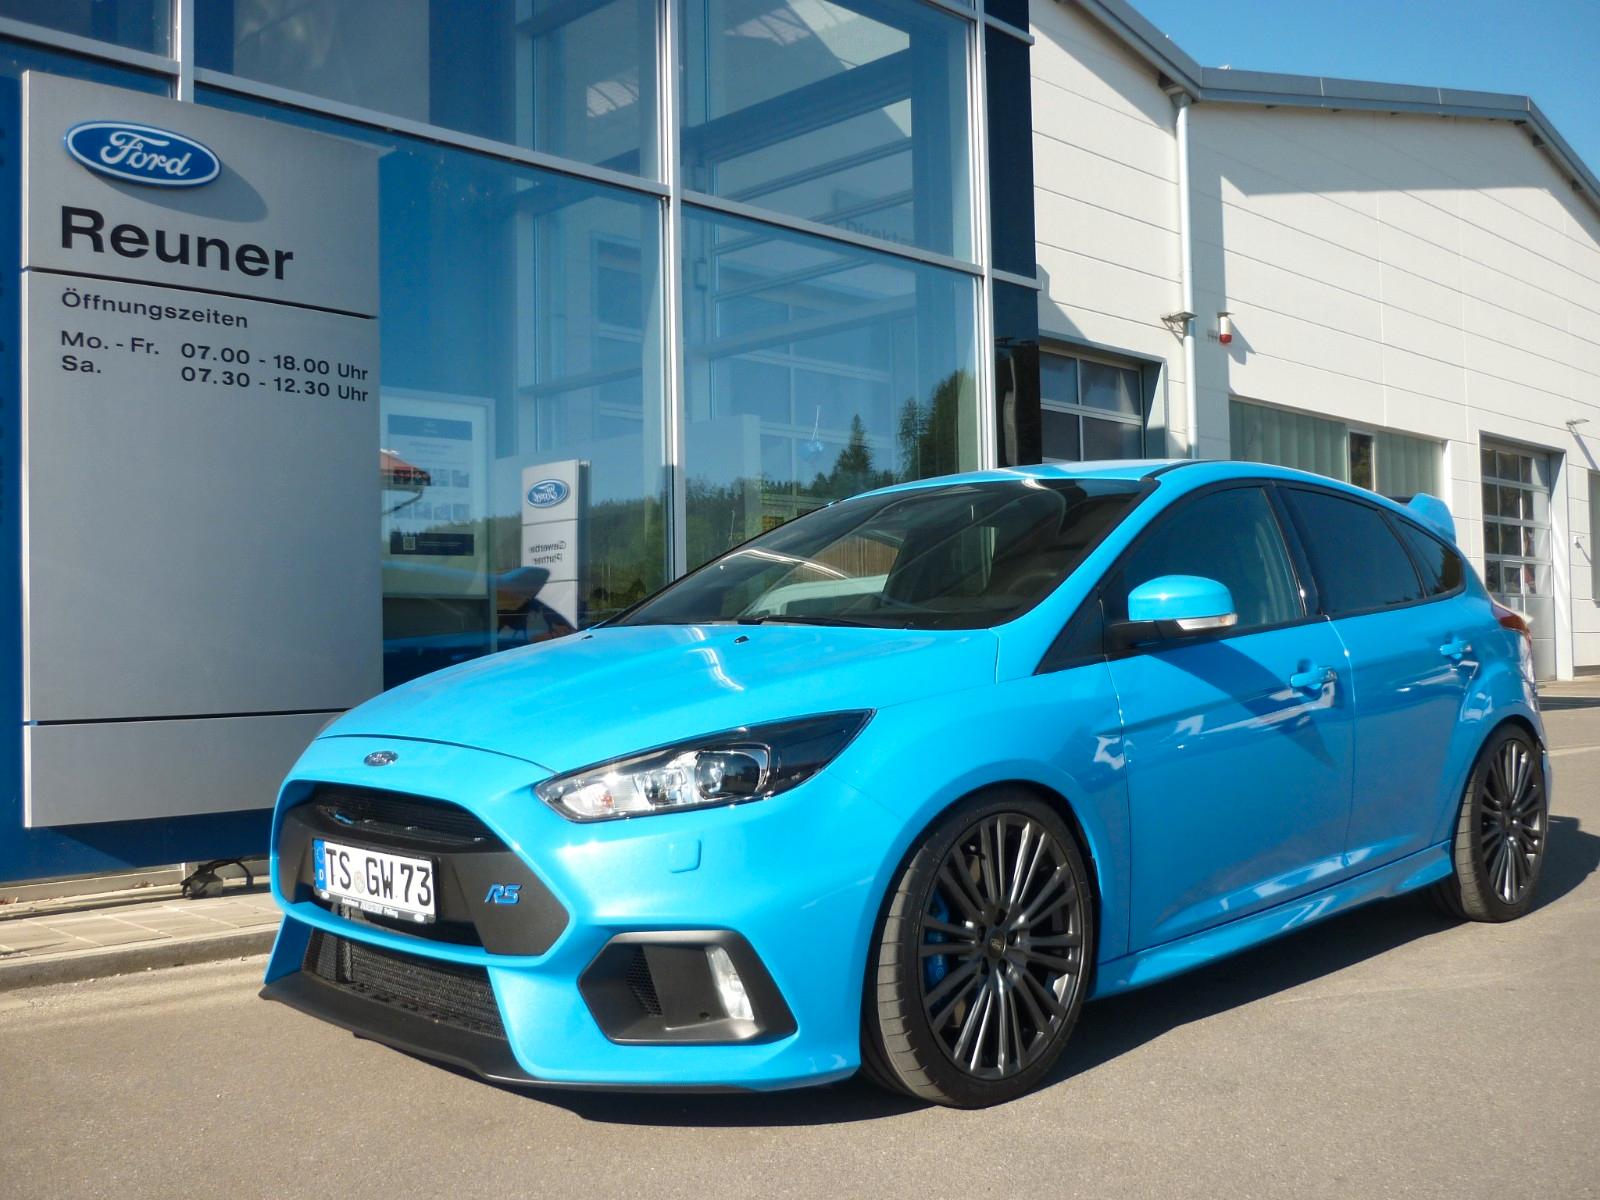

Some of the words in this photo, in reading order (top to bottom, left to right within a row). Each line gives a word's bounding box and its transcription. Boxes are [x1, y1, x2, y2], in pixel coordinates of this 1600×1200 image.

[100, 130, 192, 177] Ford
[60, 205, 295, 281] Reuner
[61, 287, 249, 329] Öffnungszeiten
[60, 330, 109, 350] Mo.
[131, 336, 160, 356] Fr.
[180, 343, 250, 365] 07.00
[273, 354, 330, 376] 18.00
[337, 362, 369, 381] Uhr
[61, 354, 102, 374] Sa.
[180, 366, 250, 388] 07.30
[273, 377, 330, 397] 12.30
[337, 384, 369, 402] Uhr
[325, 849, 351, 890] TS
[365, 856, 395, 900] GW
[400, 863, 432, 907] 73
[484, 882, 523, 904] RS
